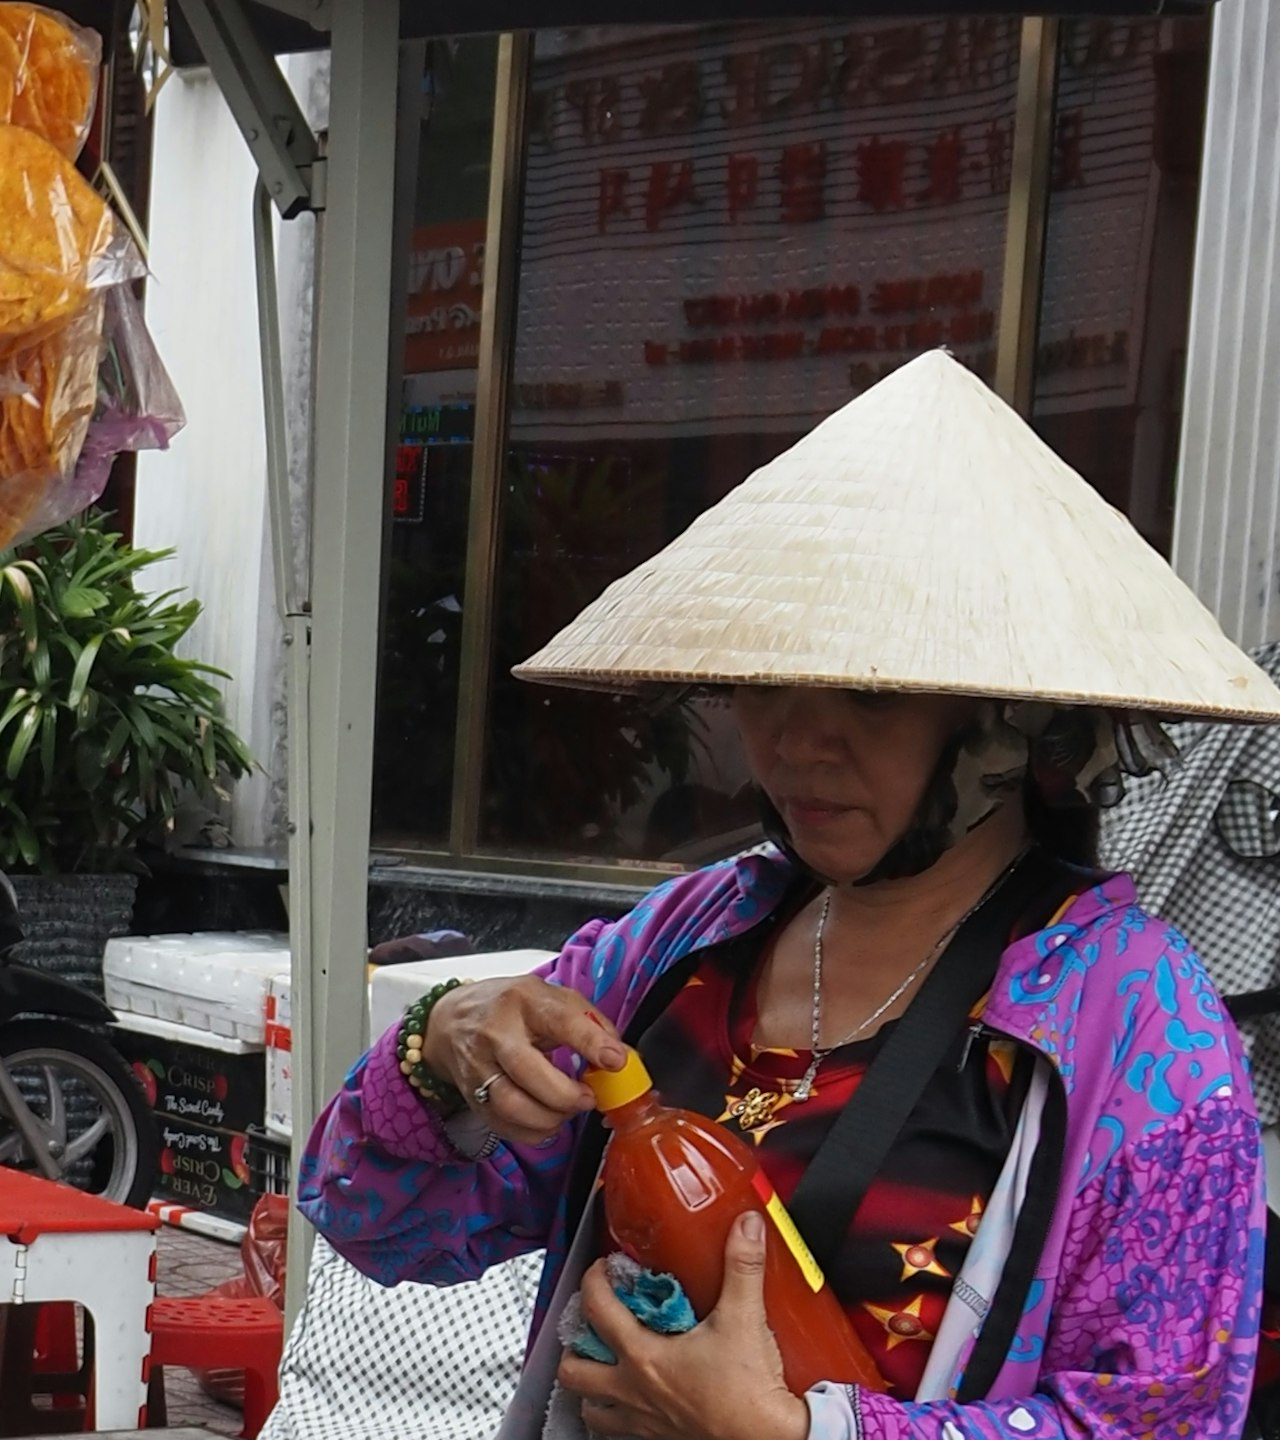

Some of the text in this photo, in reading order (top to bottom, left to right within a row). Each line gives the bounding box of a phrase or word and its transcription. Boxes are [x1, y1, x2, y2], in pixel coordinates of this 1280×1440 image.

[167, 1064, 216, 1094] CRISP
[172, 1154, 221, 1183] CRISP
[172, 1175, 218, 1208] EVER
